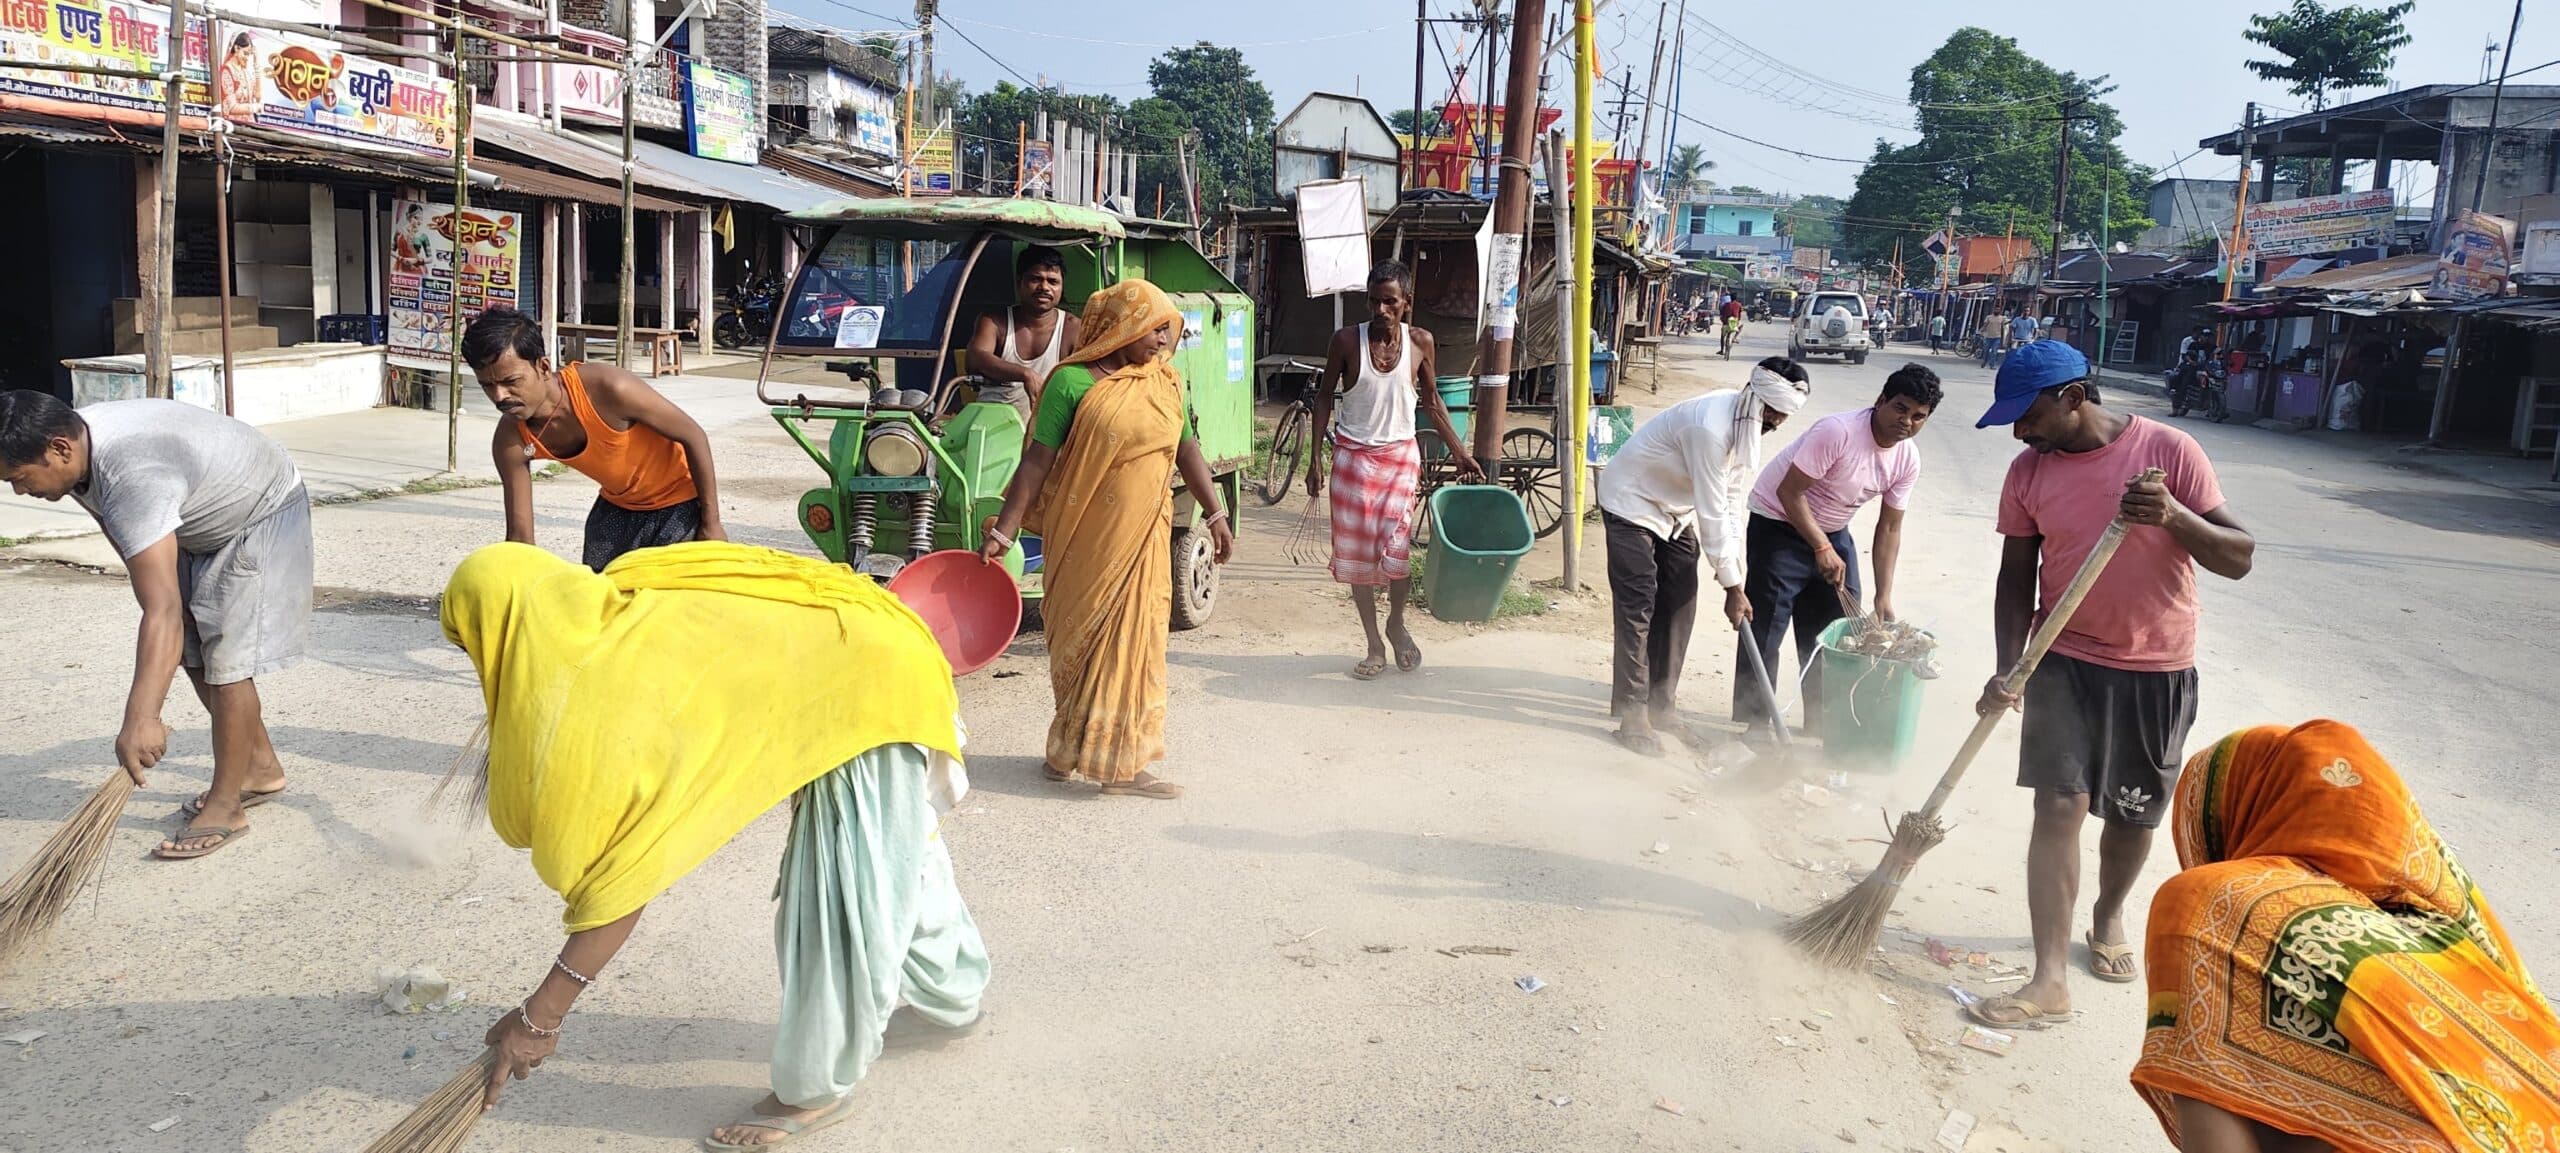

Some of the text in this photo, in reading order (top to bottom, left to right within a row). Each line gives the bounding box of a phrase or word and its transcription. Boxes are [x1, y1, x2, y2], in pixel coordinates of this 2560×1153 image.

[56, 4, 102, 46] एण्ड
[108, 6, 159, 56] गिफ्ट
[348, 68, 394, 116] ब्यूटी
[399, 81, 449, 119] पार्लर
[2116, 798, 2145, 812] adidas
